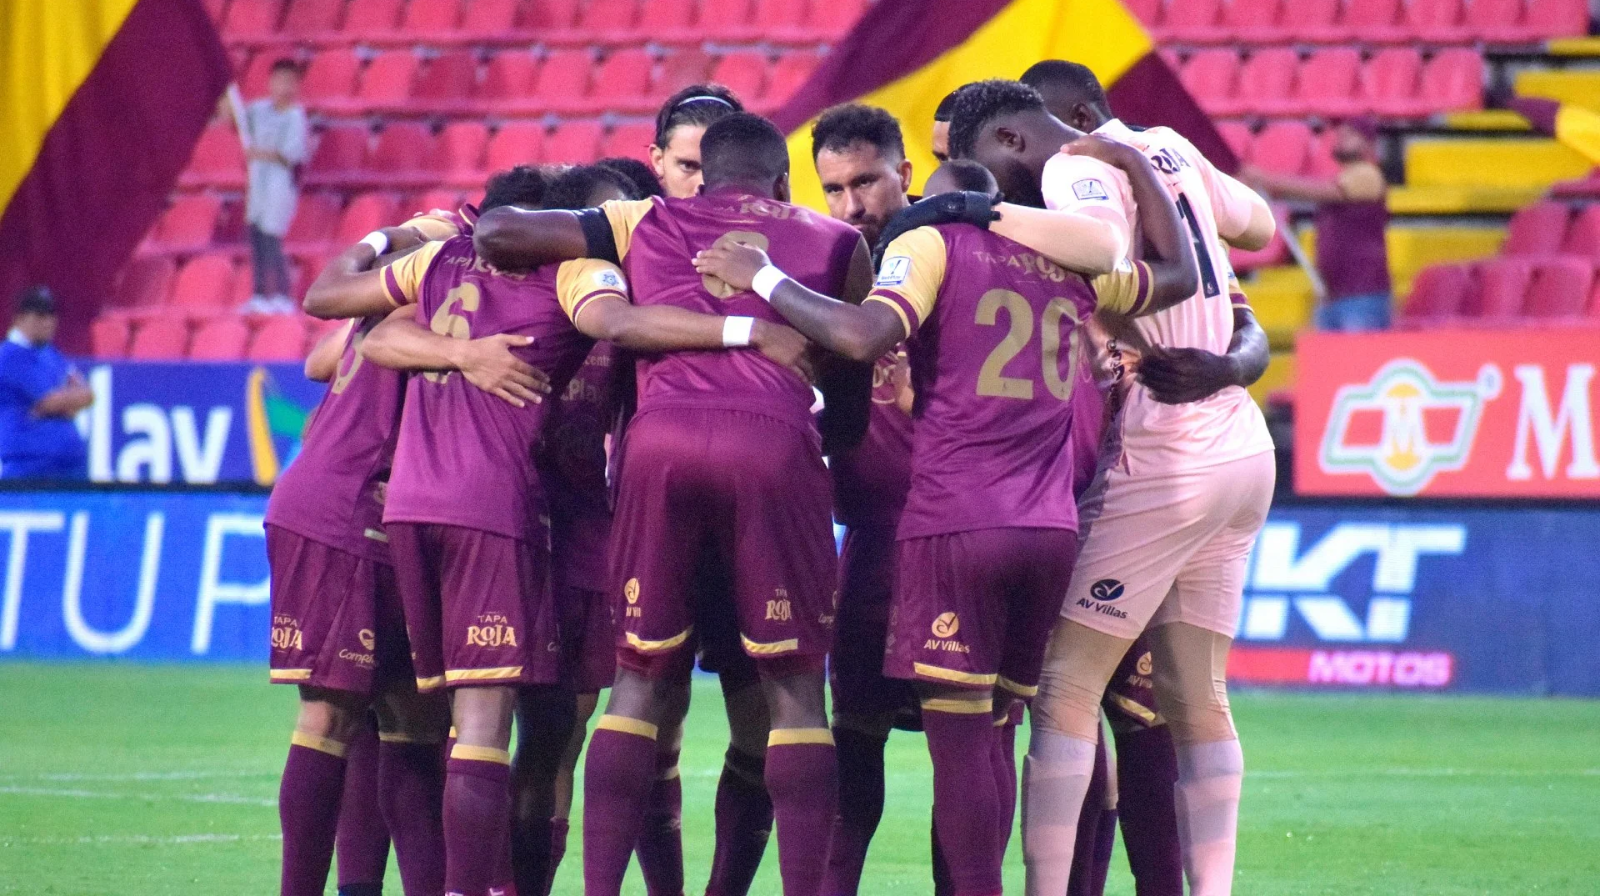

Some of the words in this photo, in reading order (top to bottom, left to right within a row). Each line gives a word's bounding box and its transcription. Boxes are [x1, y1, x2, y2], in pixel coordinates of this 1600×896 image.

[974, 288, 1079, 401] 20
[1506, 364, 1600, 480] M
[0, 510, 271, 654] TUP
[1236, 521, 1467, 641] KT
[478, 614, 508, 624] TAPA
[1076, 597, 1095, 609] AV
[1095, 602, 1128, 619] Villas
[466, 624, 517, 647] ROJA
[923, 639, 940, 650] AV
[941, 640, 970, 654] Villas
[1308, 651, 1453, 686] MOTOS
